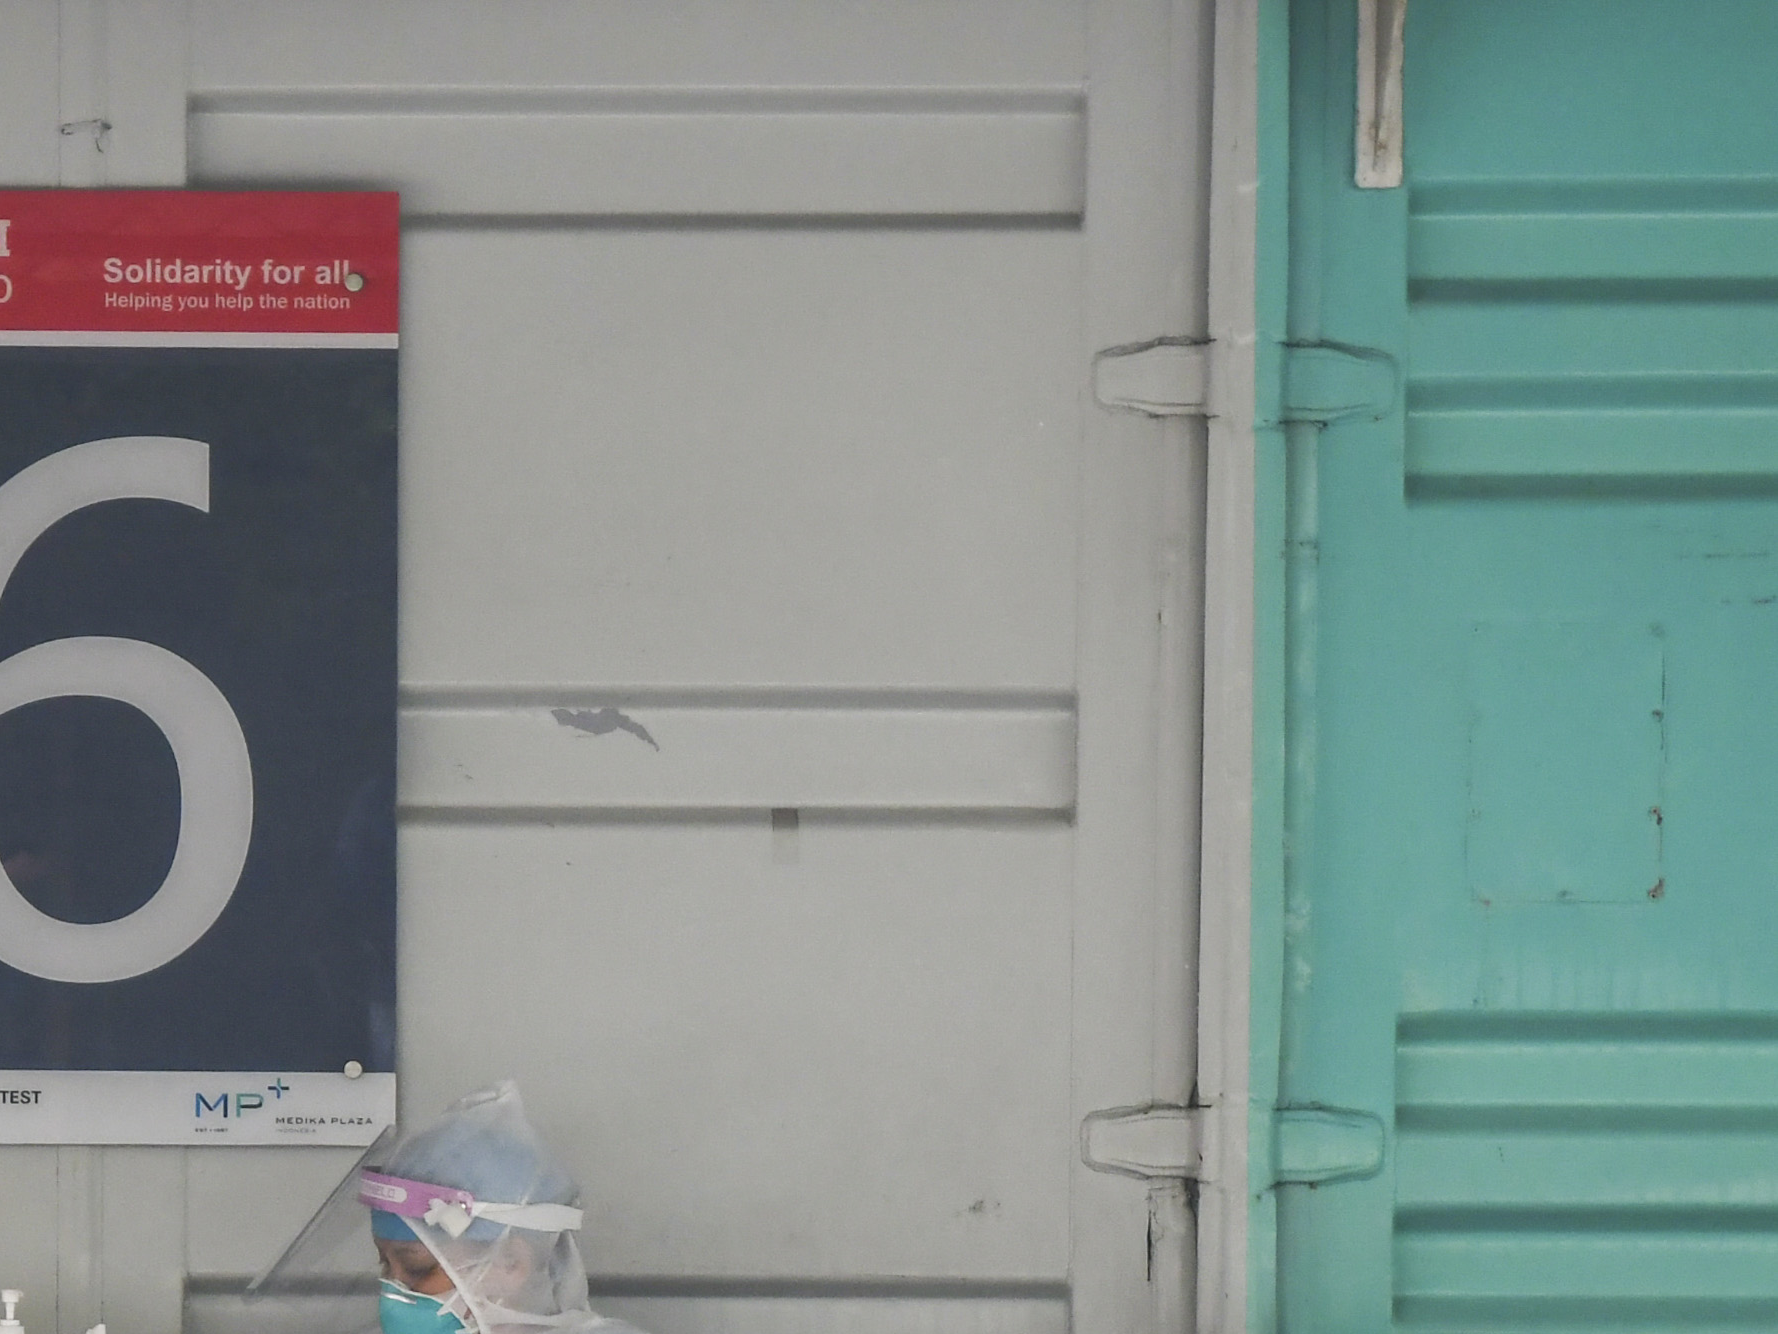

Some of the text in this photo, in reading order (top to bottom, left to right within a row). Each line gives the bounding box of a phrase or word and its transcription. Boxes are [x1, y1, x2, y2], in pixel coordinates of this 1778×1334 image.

[103, 257, 349, 290] Solidarity for all
[105, 292, 351, 312] Helping you help the nation
[0, 1090, 42, 1104] TEST
[275, 1117, 373, 1125] MEDIKA PLAZA
